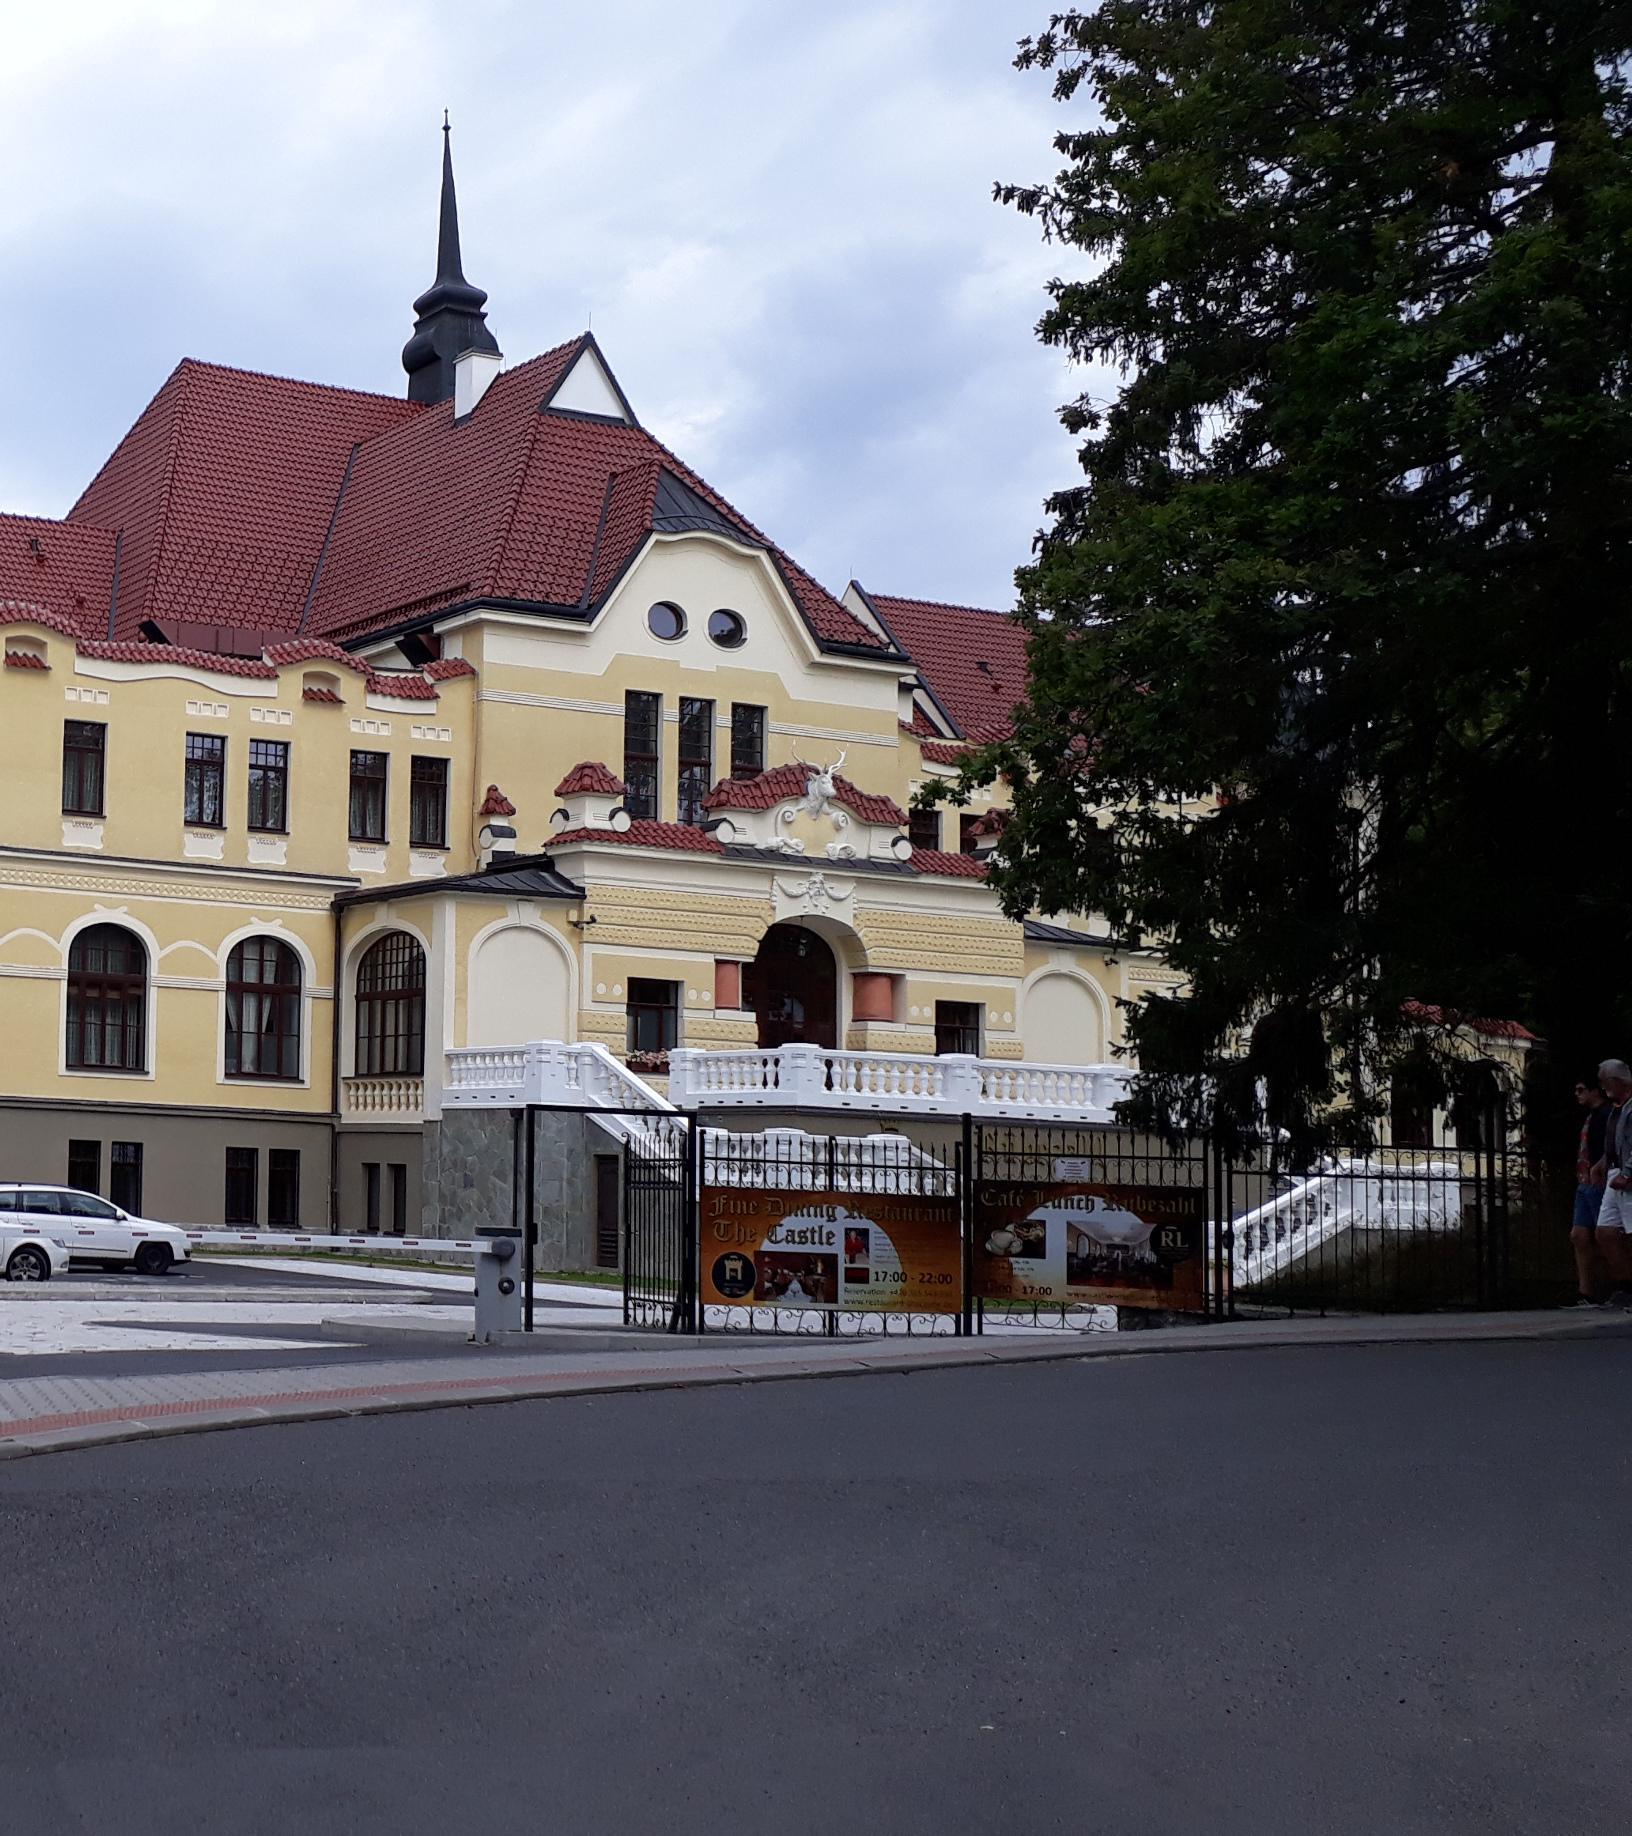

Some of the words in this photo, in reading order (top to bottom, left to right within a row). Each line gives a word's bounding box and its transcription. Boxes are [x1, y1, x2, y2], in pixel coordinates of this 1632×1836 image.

[707, 1194, 759, 1217] Fine
[765, 1196, 839, 1223] Dining
[843, 1199, 953, 1223] Restaurant
[980, 1188, 1024, 1207] Café
[1032, 1190, 1095, 1214] Lunch
[713, 1219, 758, 1246] The
[766, 1223, 837, 1246] Castle
[874, 1270, 908, 1283] 17:00
[918, 1272, 953, 1285] 22:00
[1022, 1285, 1053, 1296] 17:00
